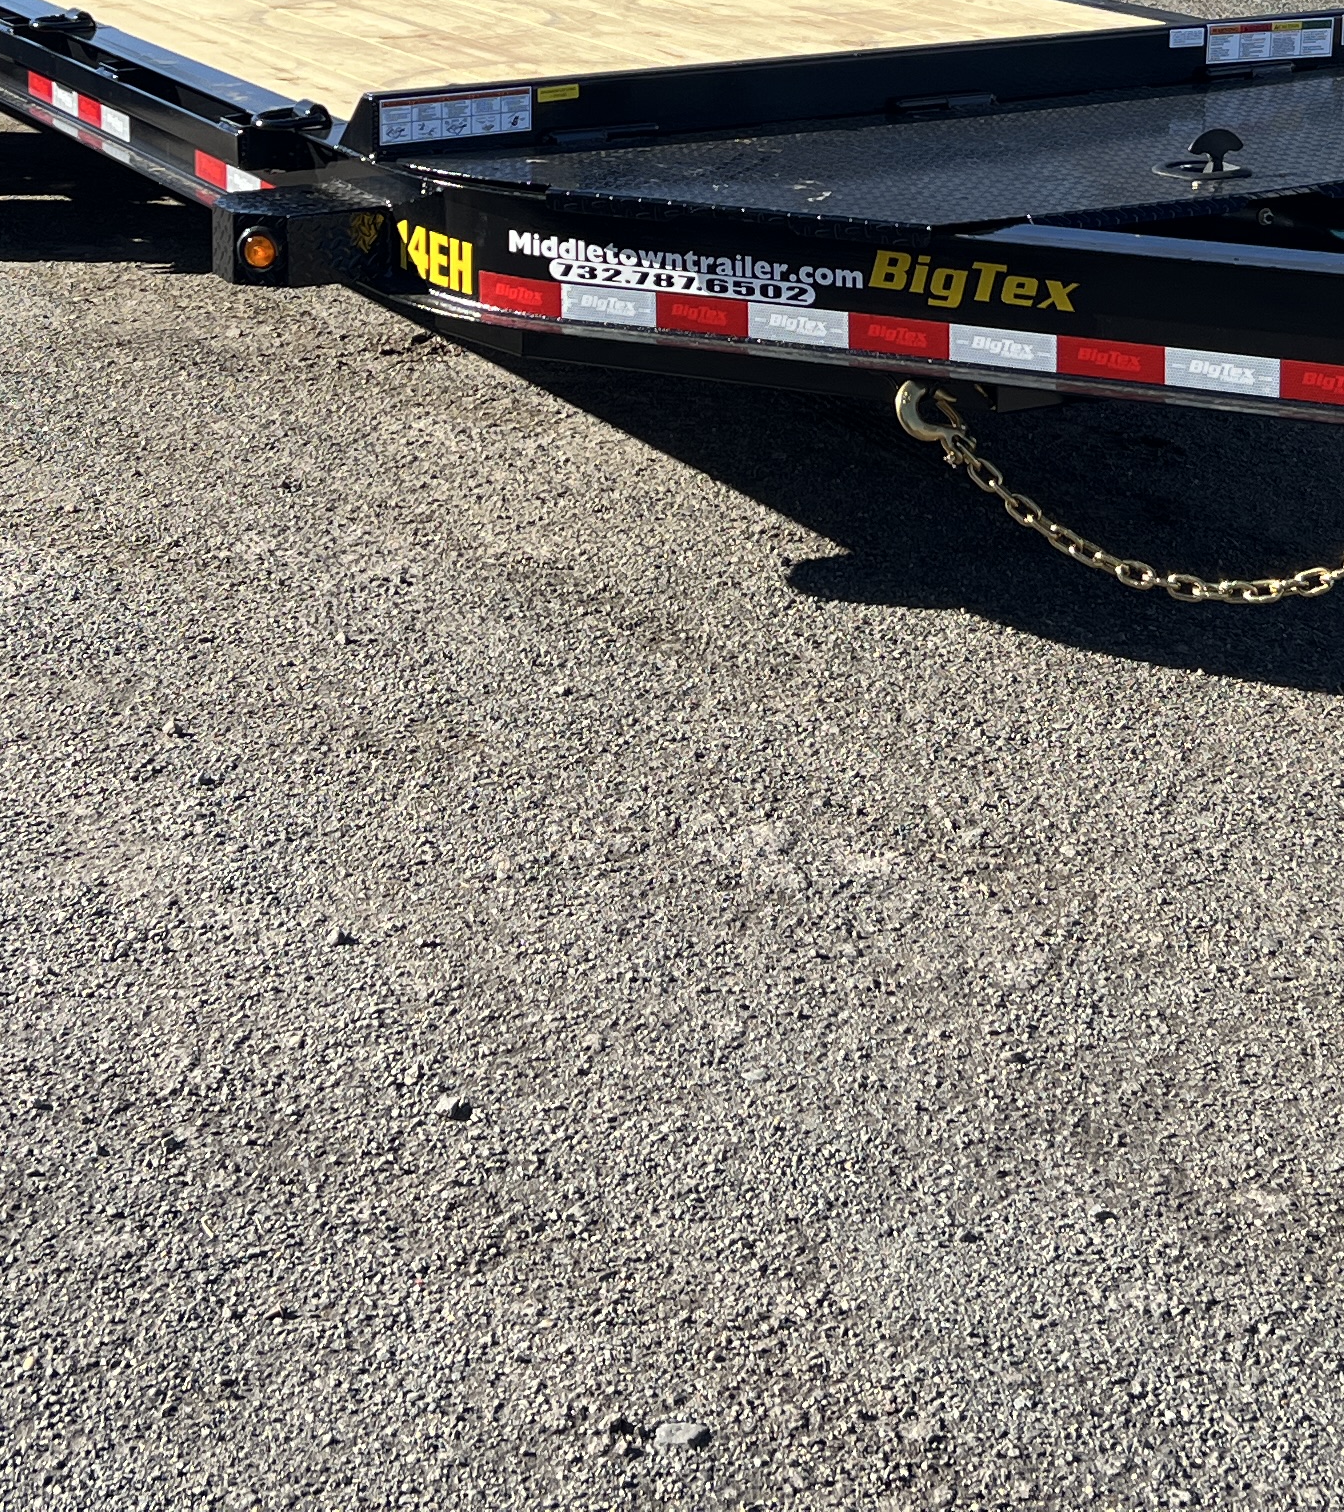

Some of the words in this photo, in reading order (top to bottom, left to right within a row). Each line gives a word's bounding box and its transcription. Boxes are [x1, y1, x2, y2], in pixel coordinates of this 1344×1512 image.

[508, 228, 864, 289] Middletowntrailer.com
[554, 261, 813, 304] 732.787.6502
[867, 249, 1081, 313] BigTex
[580, 294, 636, 315] BigTex
[671, 303, 728, 324] BigTex
[768, 313, 828, 334] BigTex
[867, 323, 927, 345] BigTex
[970, 335, 1034, 357] BigTex
[1077, 347, 1142, 369] BigTex
[1188, 359, 1256, 382] BigTex
